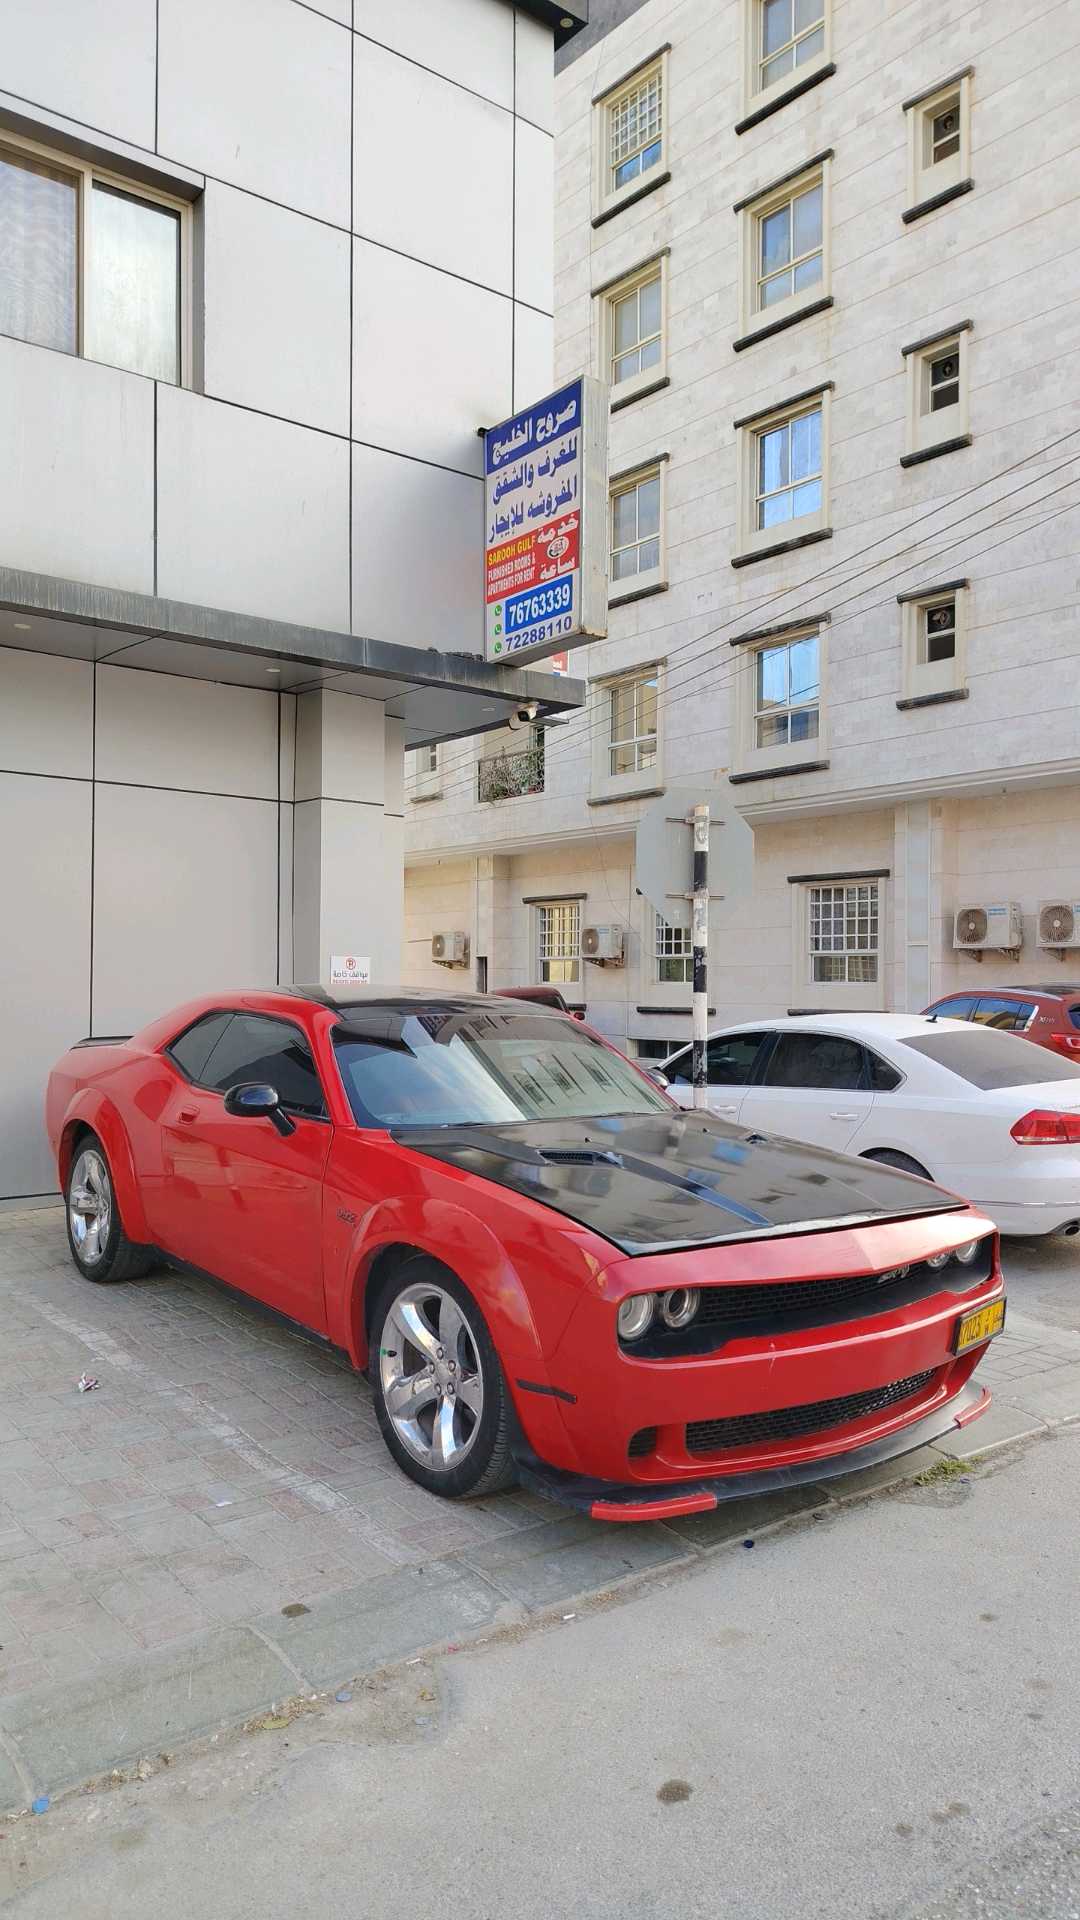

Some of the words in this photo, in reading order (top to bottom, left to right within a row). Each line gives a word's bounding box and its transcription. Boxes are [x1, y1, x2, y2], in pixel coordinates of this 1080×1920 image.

[536, 400, 577, 442] صروح
[492, 417, 533, 465] الخليج
[537, 436, 577, 477] للغرف
[493, 461, 534, 505] والشقق
[537, 514, 579, 544] خدمة
[488, 543, 516, 566] SAROOH
[517, 535, 536, 553] GULF
[488, 560, 514, 581] FURNISHED
[514, 553, 531, 572] ROOMS
[514, 571, 523, 587] FOR
[523, 566, 535, 582] RENT
[540, 556, 576, 581] ساعة
[508, 583, 571, 627] 76763339
[505, 616, 573, 651] 72288110
